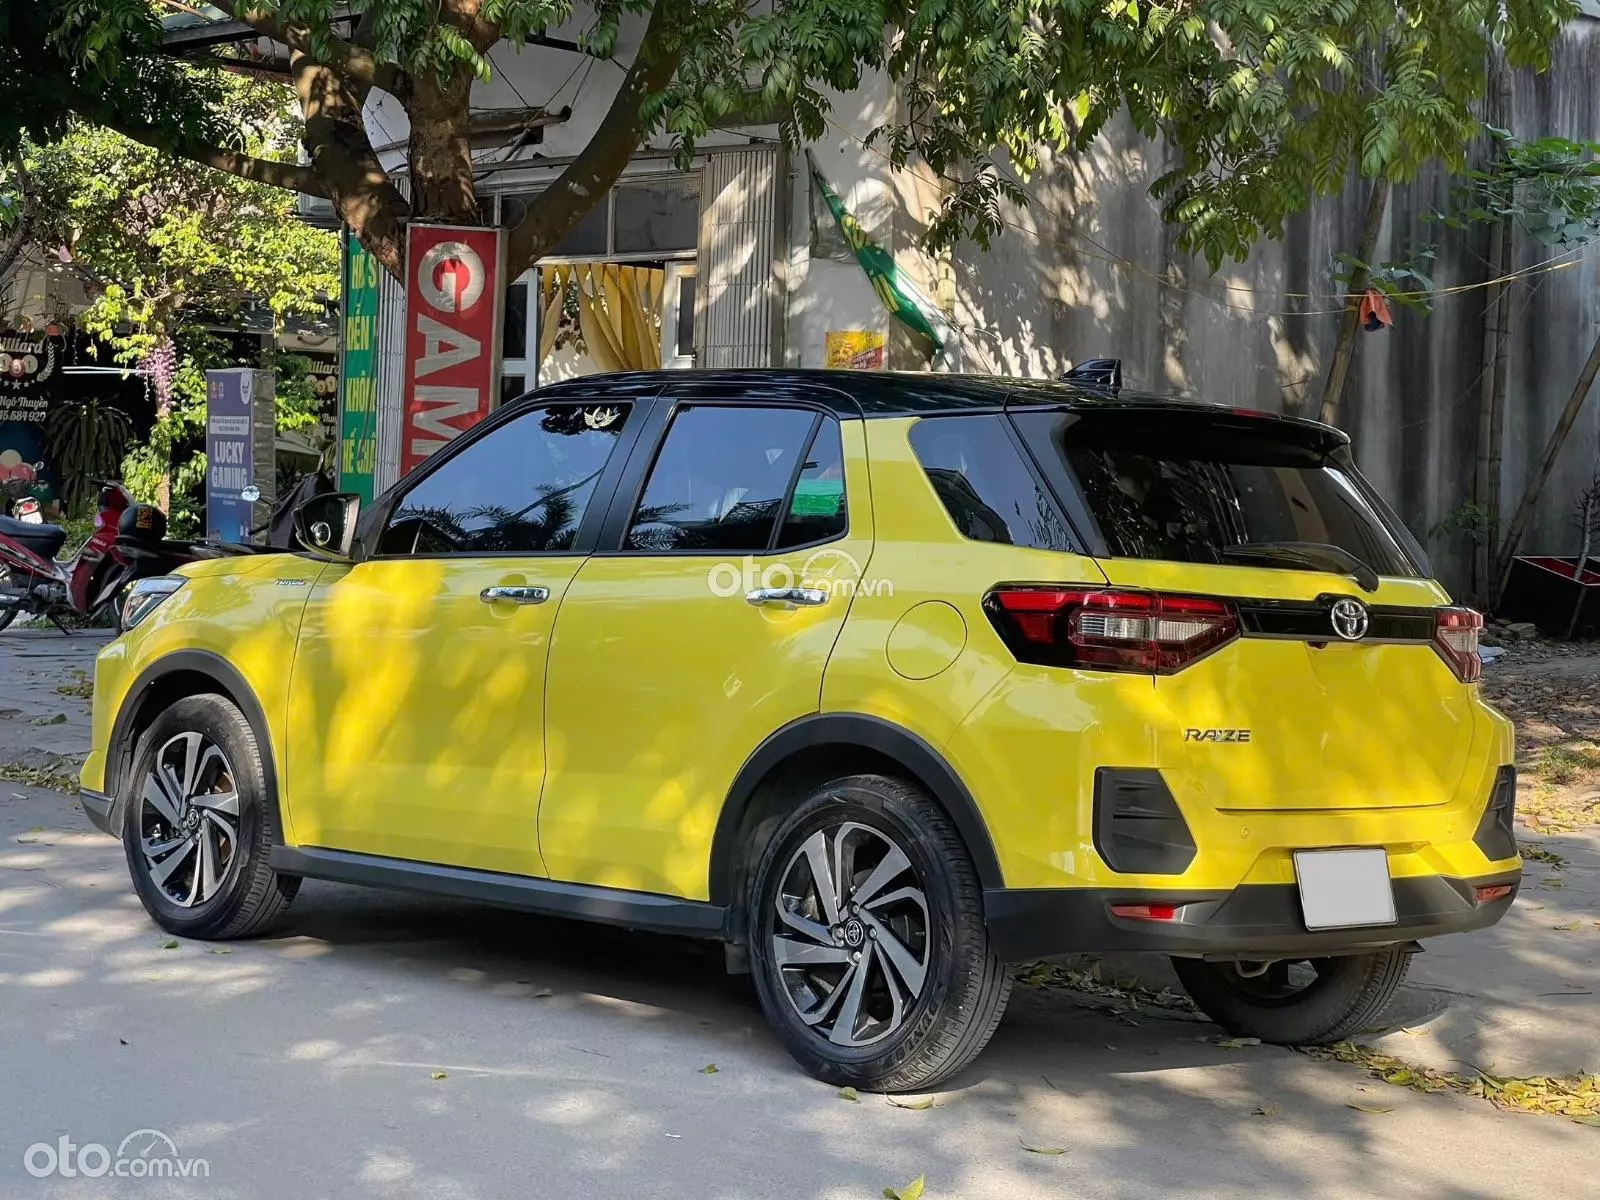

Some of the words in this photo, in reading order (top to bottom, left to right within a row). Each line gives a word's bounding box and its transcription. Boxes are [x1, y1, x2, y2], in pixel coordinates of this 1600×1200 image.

[0, 336, 43, 354] illiard
[411, 241, 485, 468] GAM
[214, 441, 245, 464] LUCKY
[211, 466, 248, 490] GAMING
[1184, 728, 1251, 742] RAIZE
